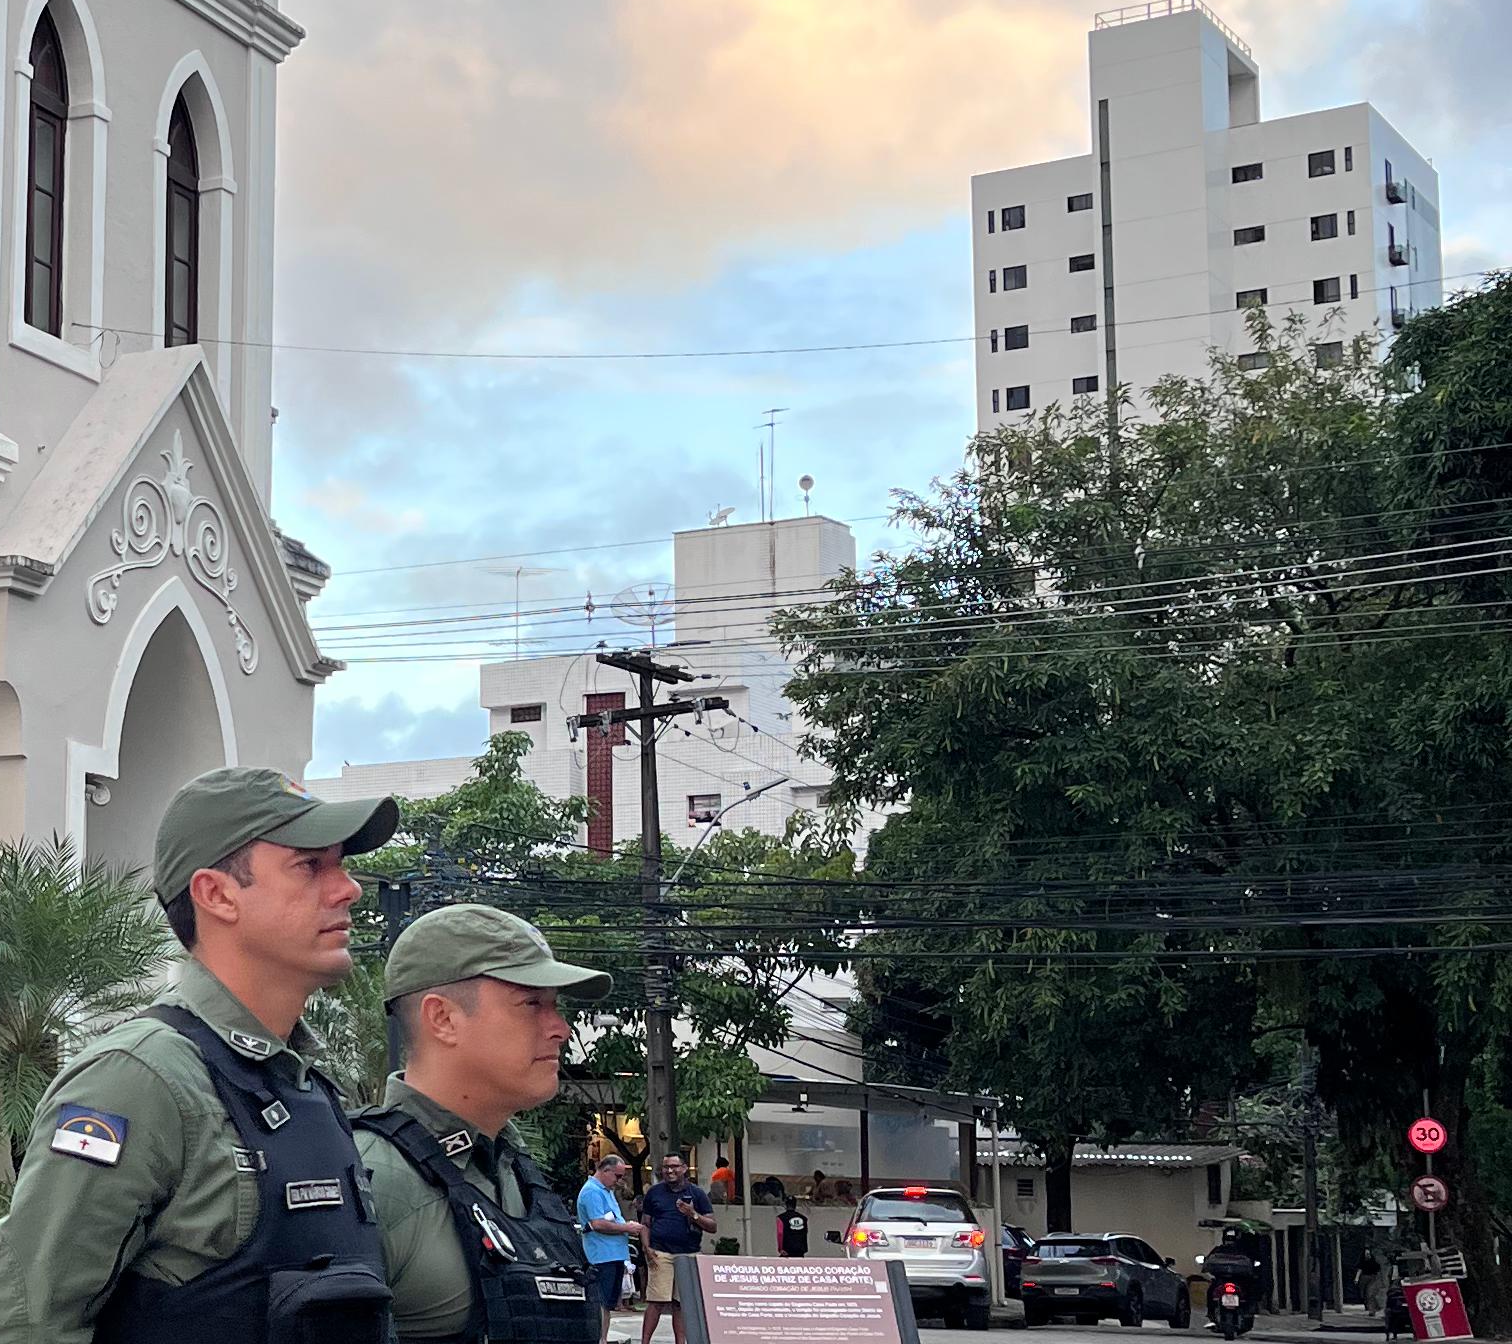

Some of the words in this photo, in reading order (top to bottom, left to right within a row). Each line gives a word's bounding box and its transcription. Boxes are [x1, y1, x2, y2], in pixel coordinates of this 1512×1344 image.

[1415, 1127, 1440, 1141] 30
[713, 1264, 760, 1274] PARÓQUIA
[761, 1266, 775, 1274] DO
[776, 1266, 823, 1274] SAGRADO
[824, 1265, 871, 1276] CORAÇÃO
[714, 1274, 728, 1283] DE
[729, 1275, 759, 1283] JESUS
[760, 1275, 797, 1285] (MATRIZ
[797, 1276, 811, 1284] DE
[812, 1276, 839, 1284] CASA
